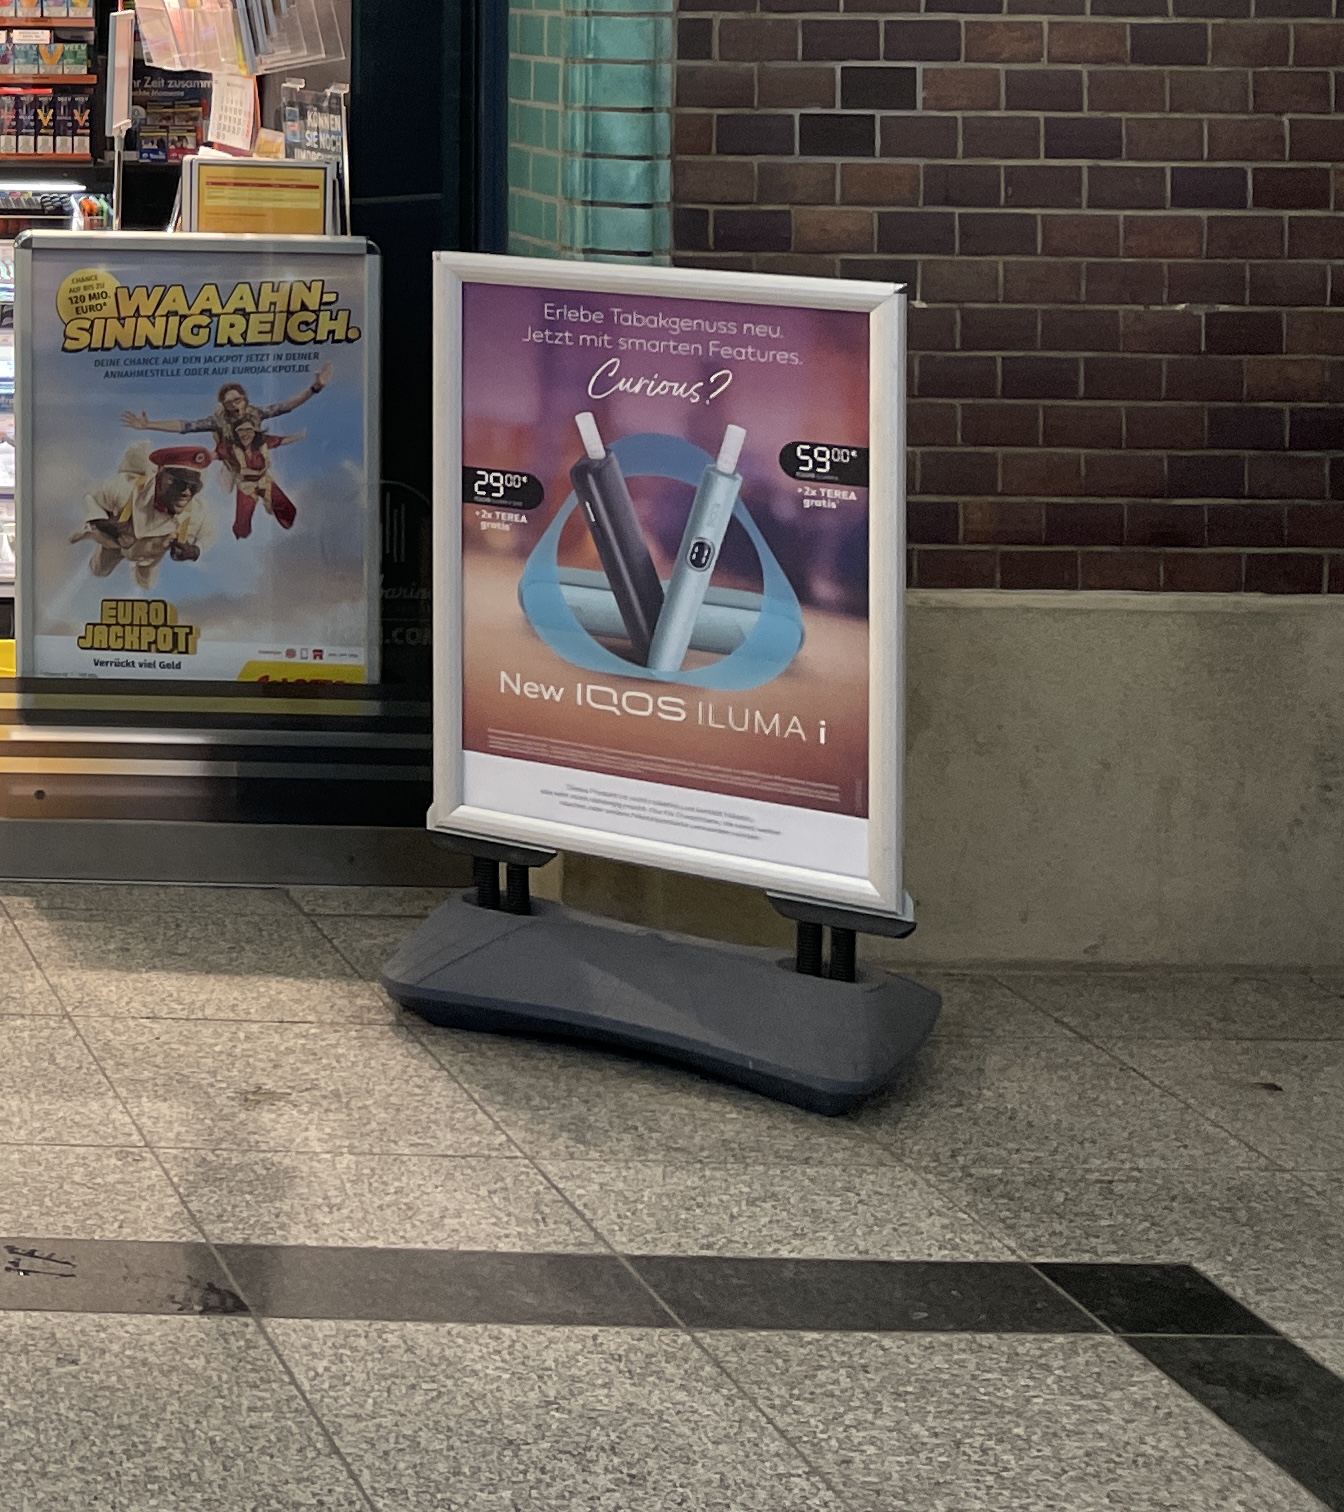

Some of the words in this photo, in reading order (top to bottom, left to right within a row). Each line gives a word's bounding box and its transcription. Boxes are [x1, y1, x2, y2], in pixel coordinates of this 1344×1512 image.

[143, 76, 165, 88] Zeit
[167, 80, 213, 88] zusamm
[68, 294, 86, 306] 120
[88, 290, 112, 303] MIO.
[115, 279, 339, 318] WAAAHN-
[62, 315, 212, 352] SINNIG
[214, 308, 362, 347] REICH.
[543, 302, 604, 324] Erlebe
[610, 307, 738, 335] Tabakgenuss
[742, 321, 785, 339] neu.
[94, 358, 120, 368] DEINE
[123, 357, 160, 367] CHANCE
[162, 356, 180, 365] AUF
[182, 355, 202, 365] DEN
[203, 354, 243, 364] JACKPOT
[245, 353, 271, 364] JETZT
[273, 352, 283, 362] IN
[285, 352, 320, 361] DEINER
[522, 326, 574, 346] Jetzt
[578, 331, 613, 349] mit
[617, 335, 703, 356] smarten
[708, 340, 804, 366] Features.
[103, 368, 182, 380] ANNAHMESTELLE
[184, 368, 210, 377] ODER
[211, 366, 229, 376] AUF
[231, 364, 311, 376] EUROJACKPOT.DE
[587, 357, 733, 405] Curious?
[819, 488, 858, 501] TEREA
[494, 511, 528, 524] TEREA
[100, 598, 169, 626] EURO
[77, 622, 194, 654] JACKPOT
[93, 657, 136, 669] Verrückt
[138, 658, 157, 669] viel
[158, 660, 182, 671] Geld
[499, 669, 565, 703] New
[575, 682, 687, 722] IQOS
[697, 701, 808, 743] ILUMA
[818, 719, 827, 745] i
